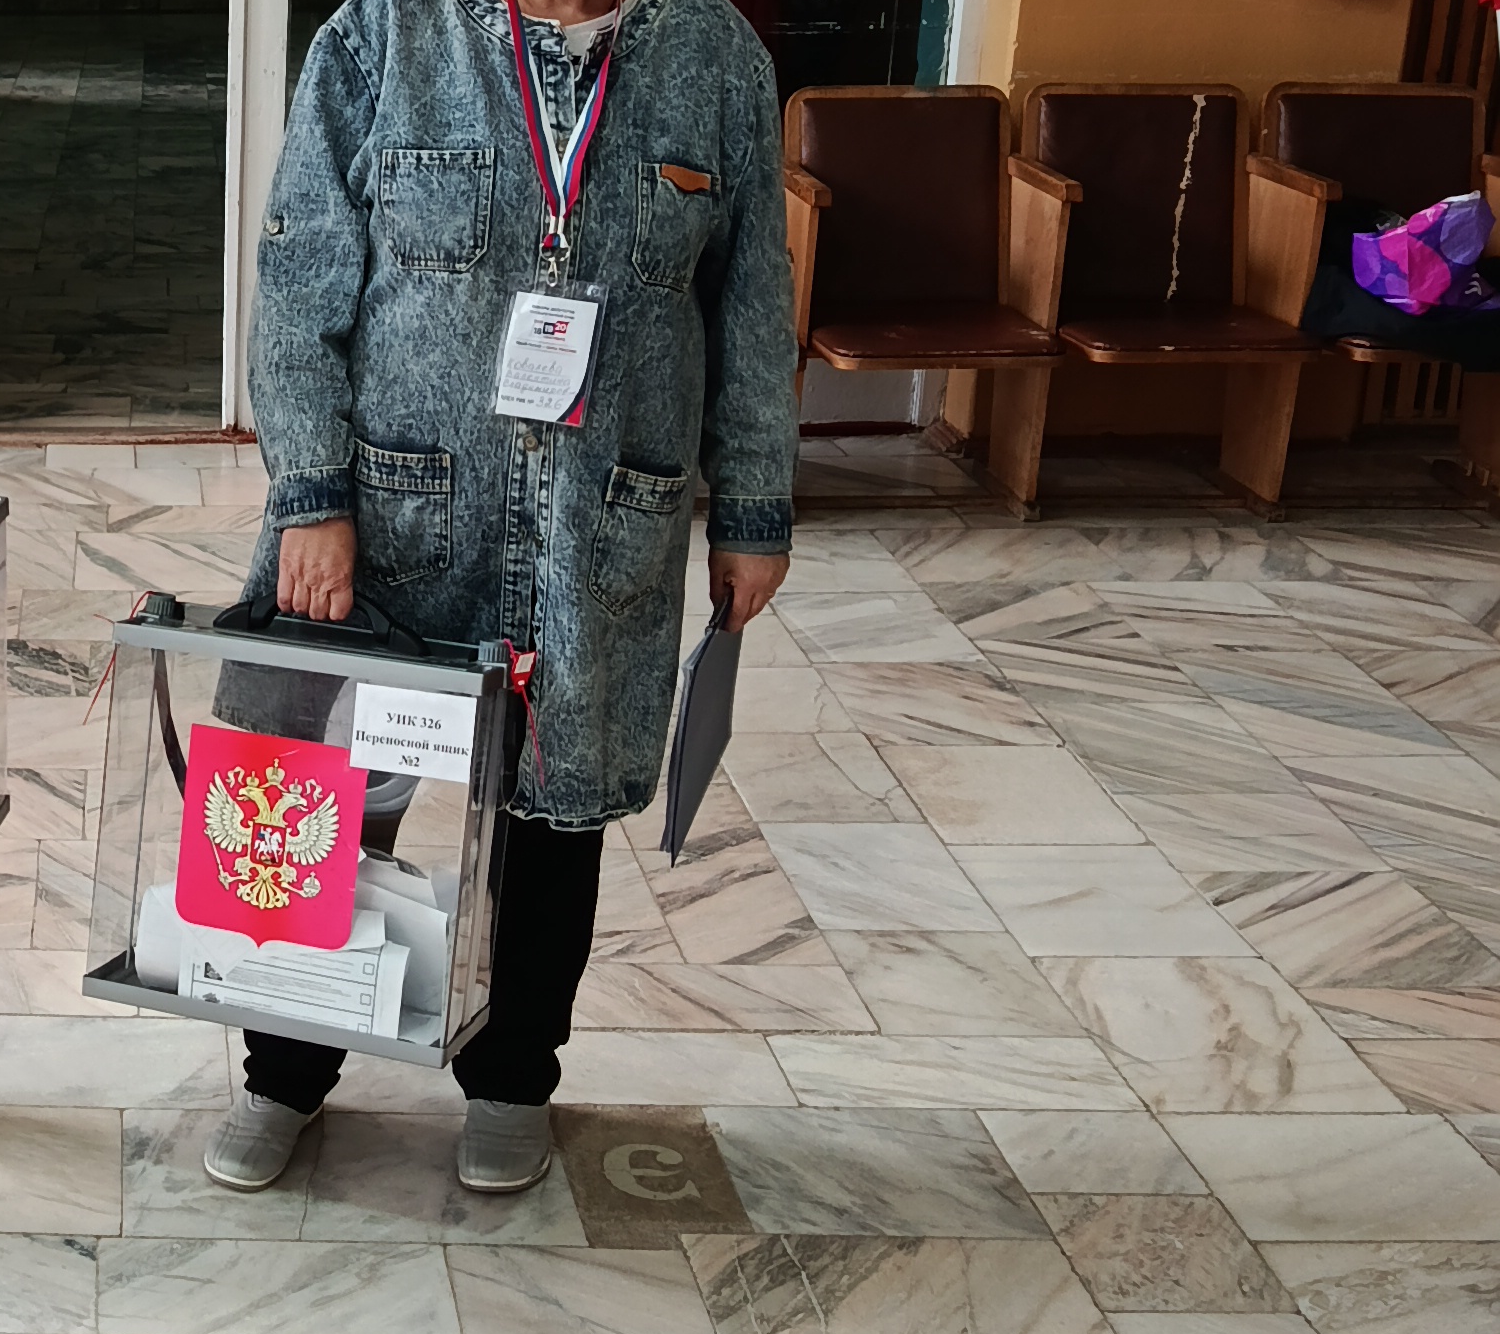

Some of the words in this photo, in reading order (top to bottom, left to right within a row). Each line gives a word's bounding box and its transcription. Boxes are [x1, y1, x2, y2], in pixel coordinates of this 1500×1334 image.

[554, 322, 567, 332] 20
[535, 396, 564, 410] 326
[386, 712, 418, 727] УИК
[419, 716, 442, 730] 326
[355, 729, 430, 751] Переносной
[432, 742, 470, 757] ящик
[398, 754, 421, 768] №2
